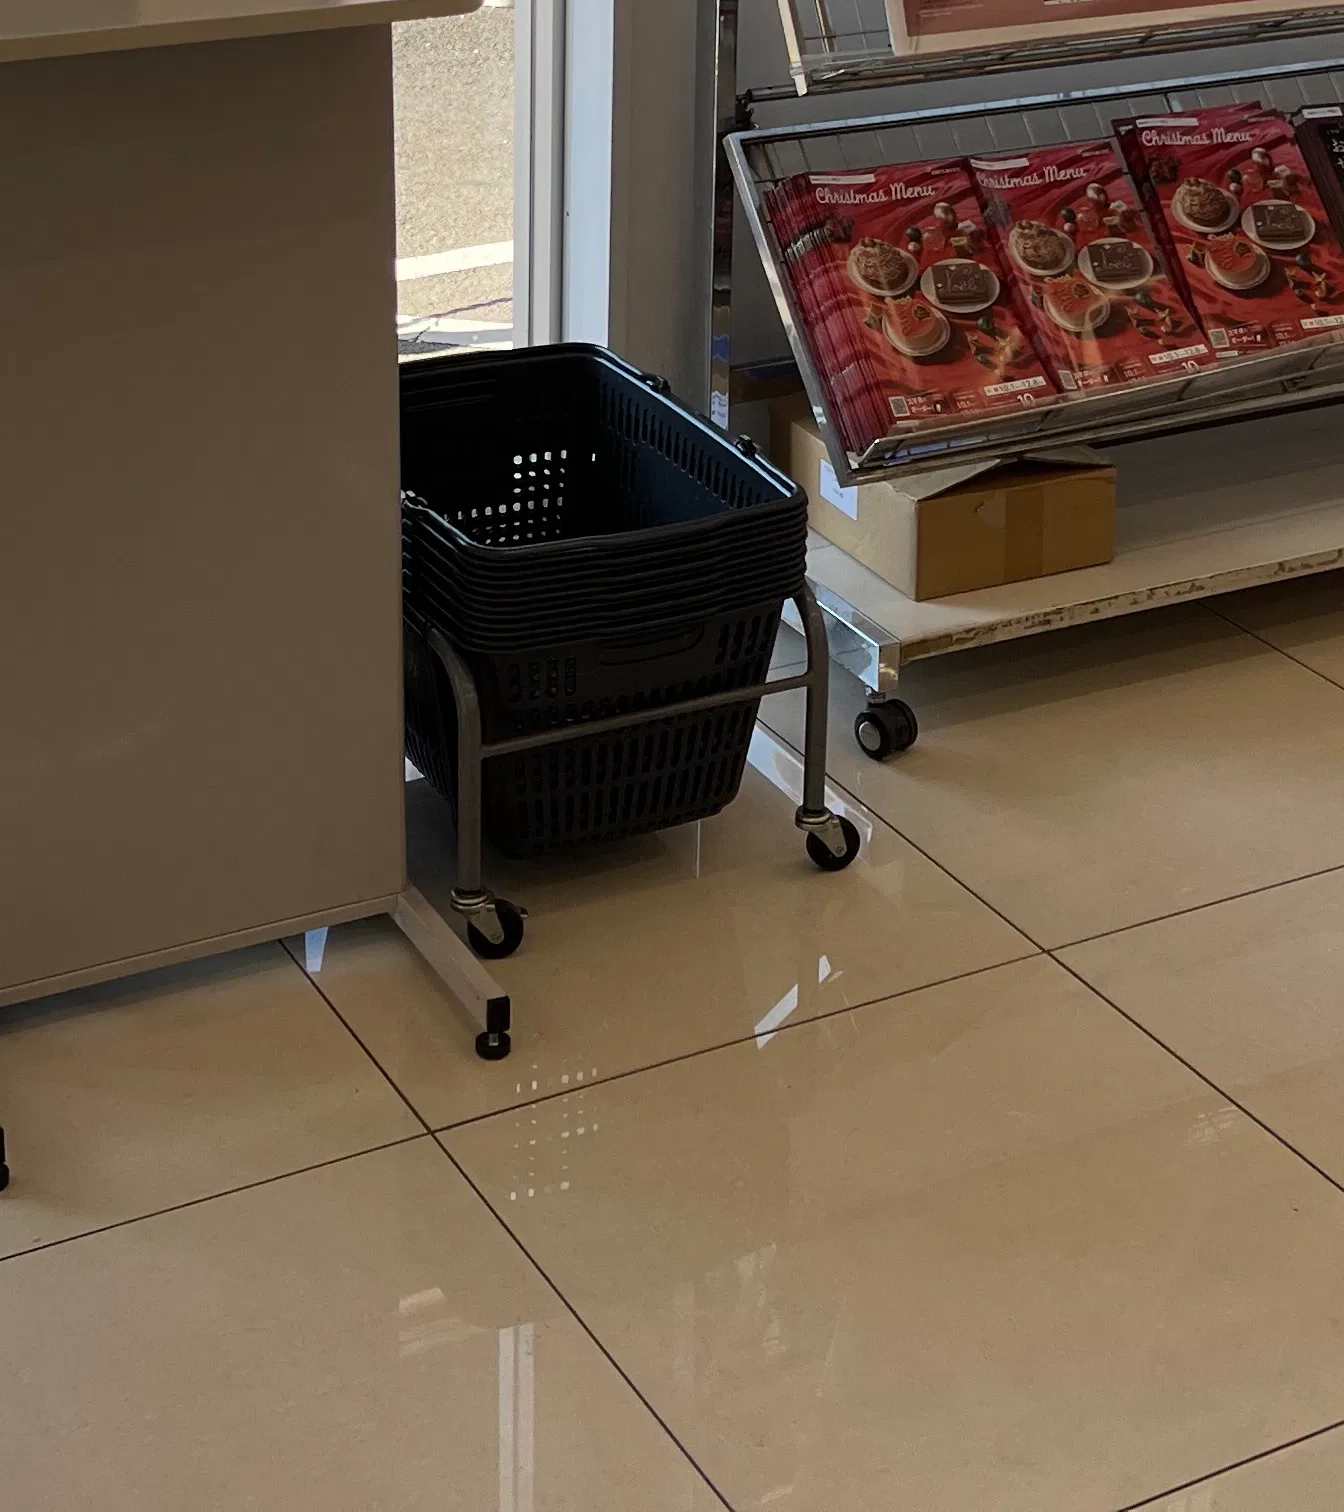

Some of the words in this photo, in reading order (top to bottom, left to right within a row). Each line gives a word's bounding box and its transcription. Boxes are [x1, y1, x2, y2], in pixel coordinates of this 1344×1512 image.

[1141, 129, 1211, 148] Christmas
[1211, 126, 1253, 144] Menu
[975, 170, 1043, 189] Christmas
[1043, 165, 1088, 182] Menu
[815, 186, 889, 205] Christmas
[890, 181, 936, 201] Menu
